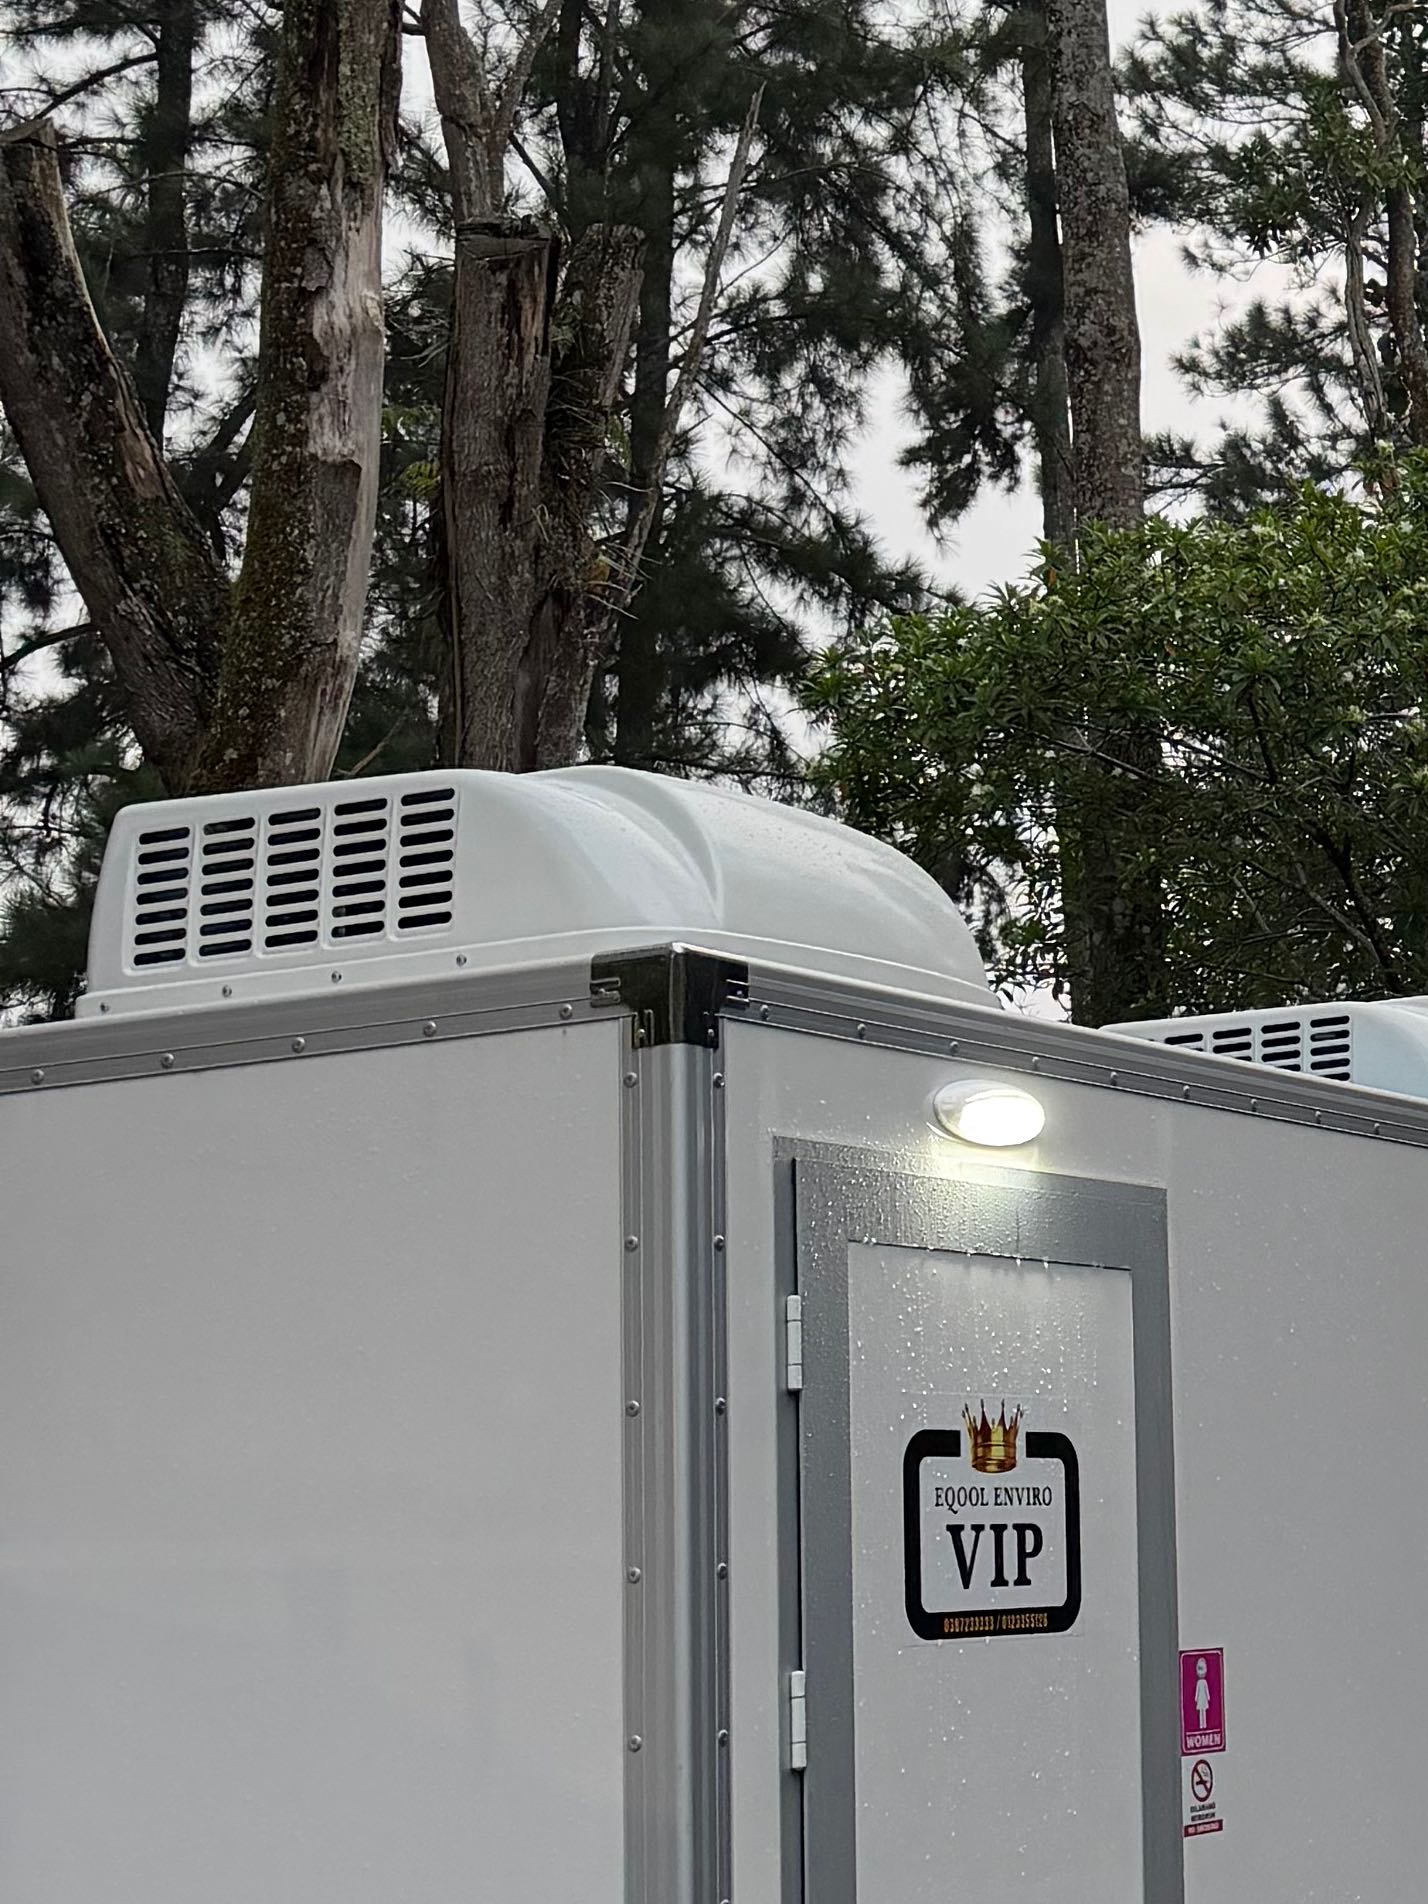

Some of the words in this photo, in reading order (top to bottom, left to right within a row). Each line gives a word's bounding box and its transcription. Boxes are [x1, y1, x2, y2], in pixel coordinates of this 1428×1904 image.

[935, 1487, 989, 1515] EQOOL
[994, 1486, 1053, 1507] ENVIRO
[946, 1523, 1043, 1590] VIP
[1186, 1733, 1221, 1749] WOMEN
